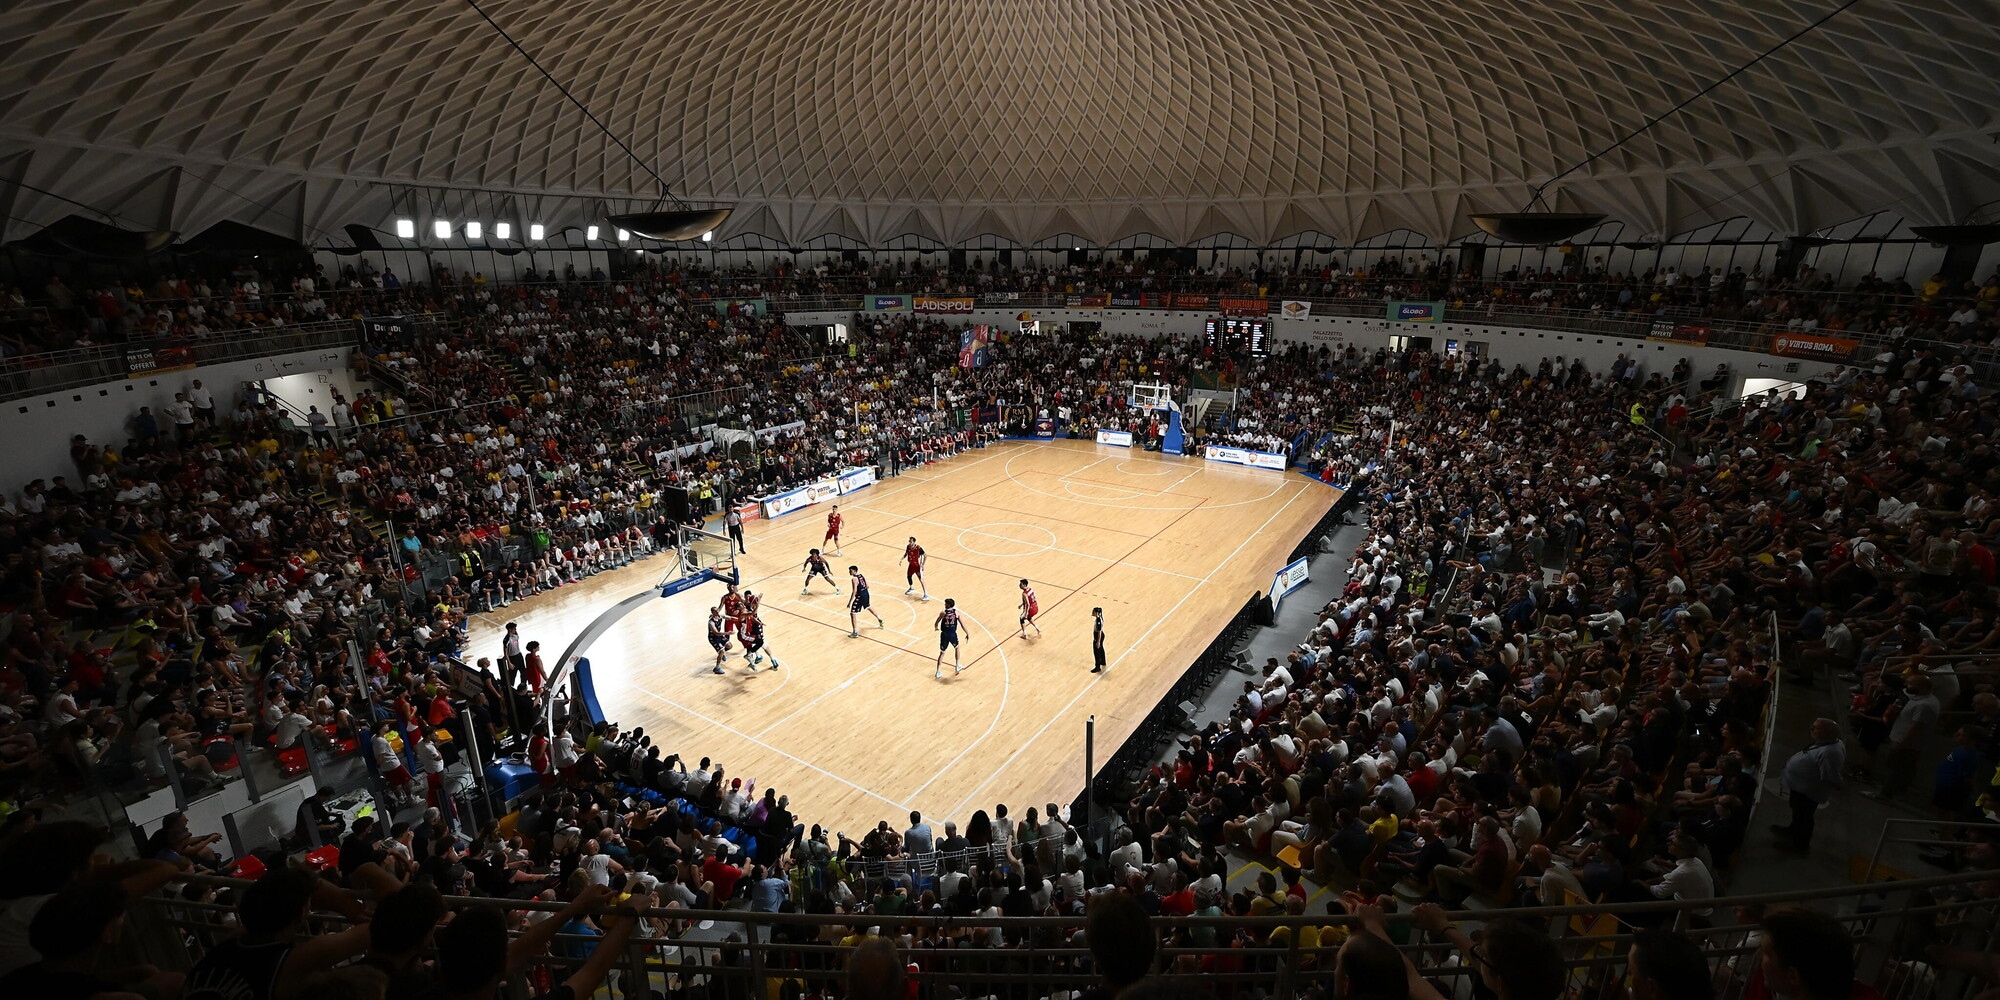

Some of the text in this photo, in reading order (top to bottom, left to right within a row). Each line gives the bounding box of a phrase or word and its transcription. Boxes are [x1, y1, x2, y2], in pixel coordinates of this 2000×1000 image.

[914, 300, 973, 311] LADISPOLI
[1789, 340, 1813, 350] VIRTUS
[1813, 343, 1833, 352] ROMA
[130, 361, 156, 370] OFFERTE
[318, 375, 327, 383] F2
[1012, 408, 1025, 416] RM
